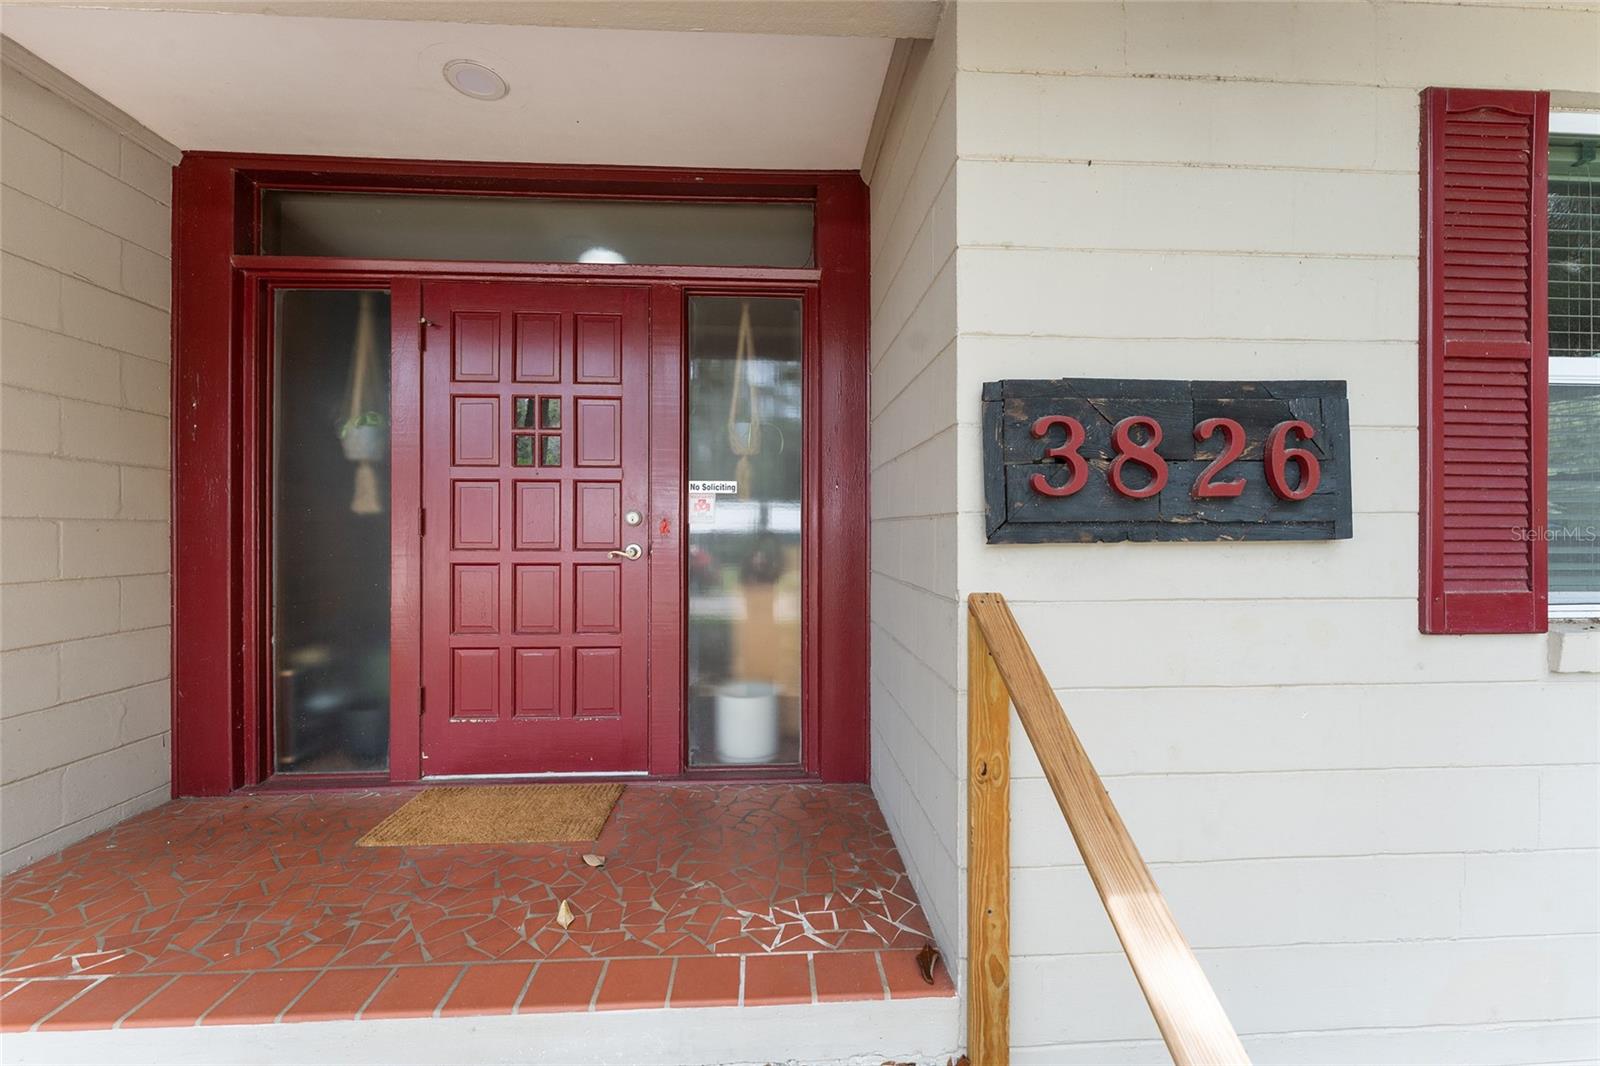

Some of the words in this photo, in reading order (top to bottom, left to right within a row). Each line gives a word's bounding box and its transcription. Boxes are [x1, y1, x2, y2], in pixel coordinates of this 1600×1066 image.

[1029, 414, 1321, 500] 3826
[690, 483, 700, 491] No
[702, 483, 736, 492] Soliciting
